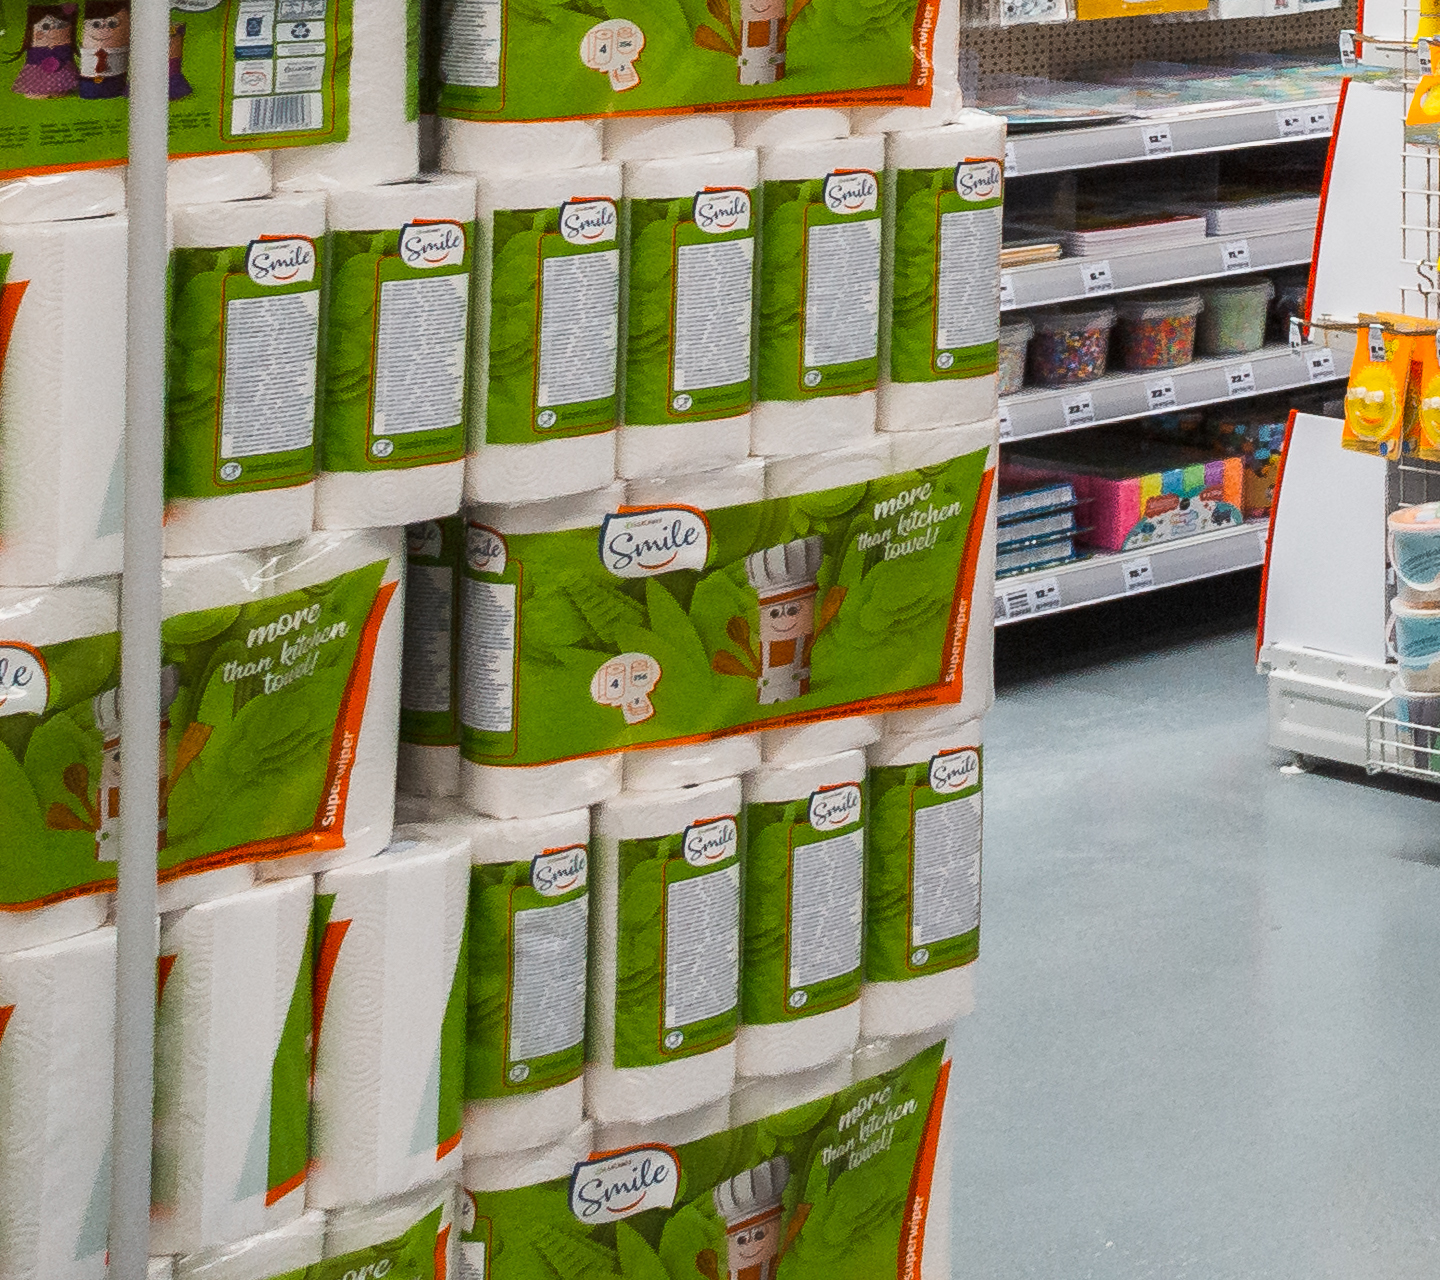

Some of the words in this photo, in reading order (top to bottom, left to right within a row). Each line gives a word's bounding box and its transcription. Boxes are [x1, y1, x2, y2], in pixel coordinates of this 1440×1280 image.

[916, 3, 935, 86] Superwiper
[828, 180, 875, 208] Smile
[563, 208, 617, 237] Smile
[697, 198, 750, 227] Smile
[251, 246, 313, 280] Smile
[404, 232, 462, 261] Smile
[872, 480, 934, 521] more
[857, 528, 892, 553] than
[897, 501, 962, 541] kitchen
[605, 520, 700, 570] Smile
[882, 528, 939, 561] towel!
[246, 601, 322, 650] more
[945, 597, 970, 684] Superwiper
[222, 657, 273, 683] than
[320, 730, 354, 828] Superwiper
[932, 754, 976, 788] Smile
[813, 793, 858, 824] Smile
[686, 832, 736, 861] Smile
[536, 856, 588, 889] Smile
[837, 1085, 893, 1131] more
[821, 1139, 856, 1167] than
[858, 1098, 919, 1147] kitchen
[577, 1162, 671, 1213] Smile
